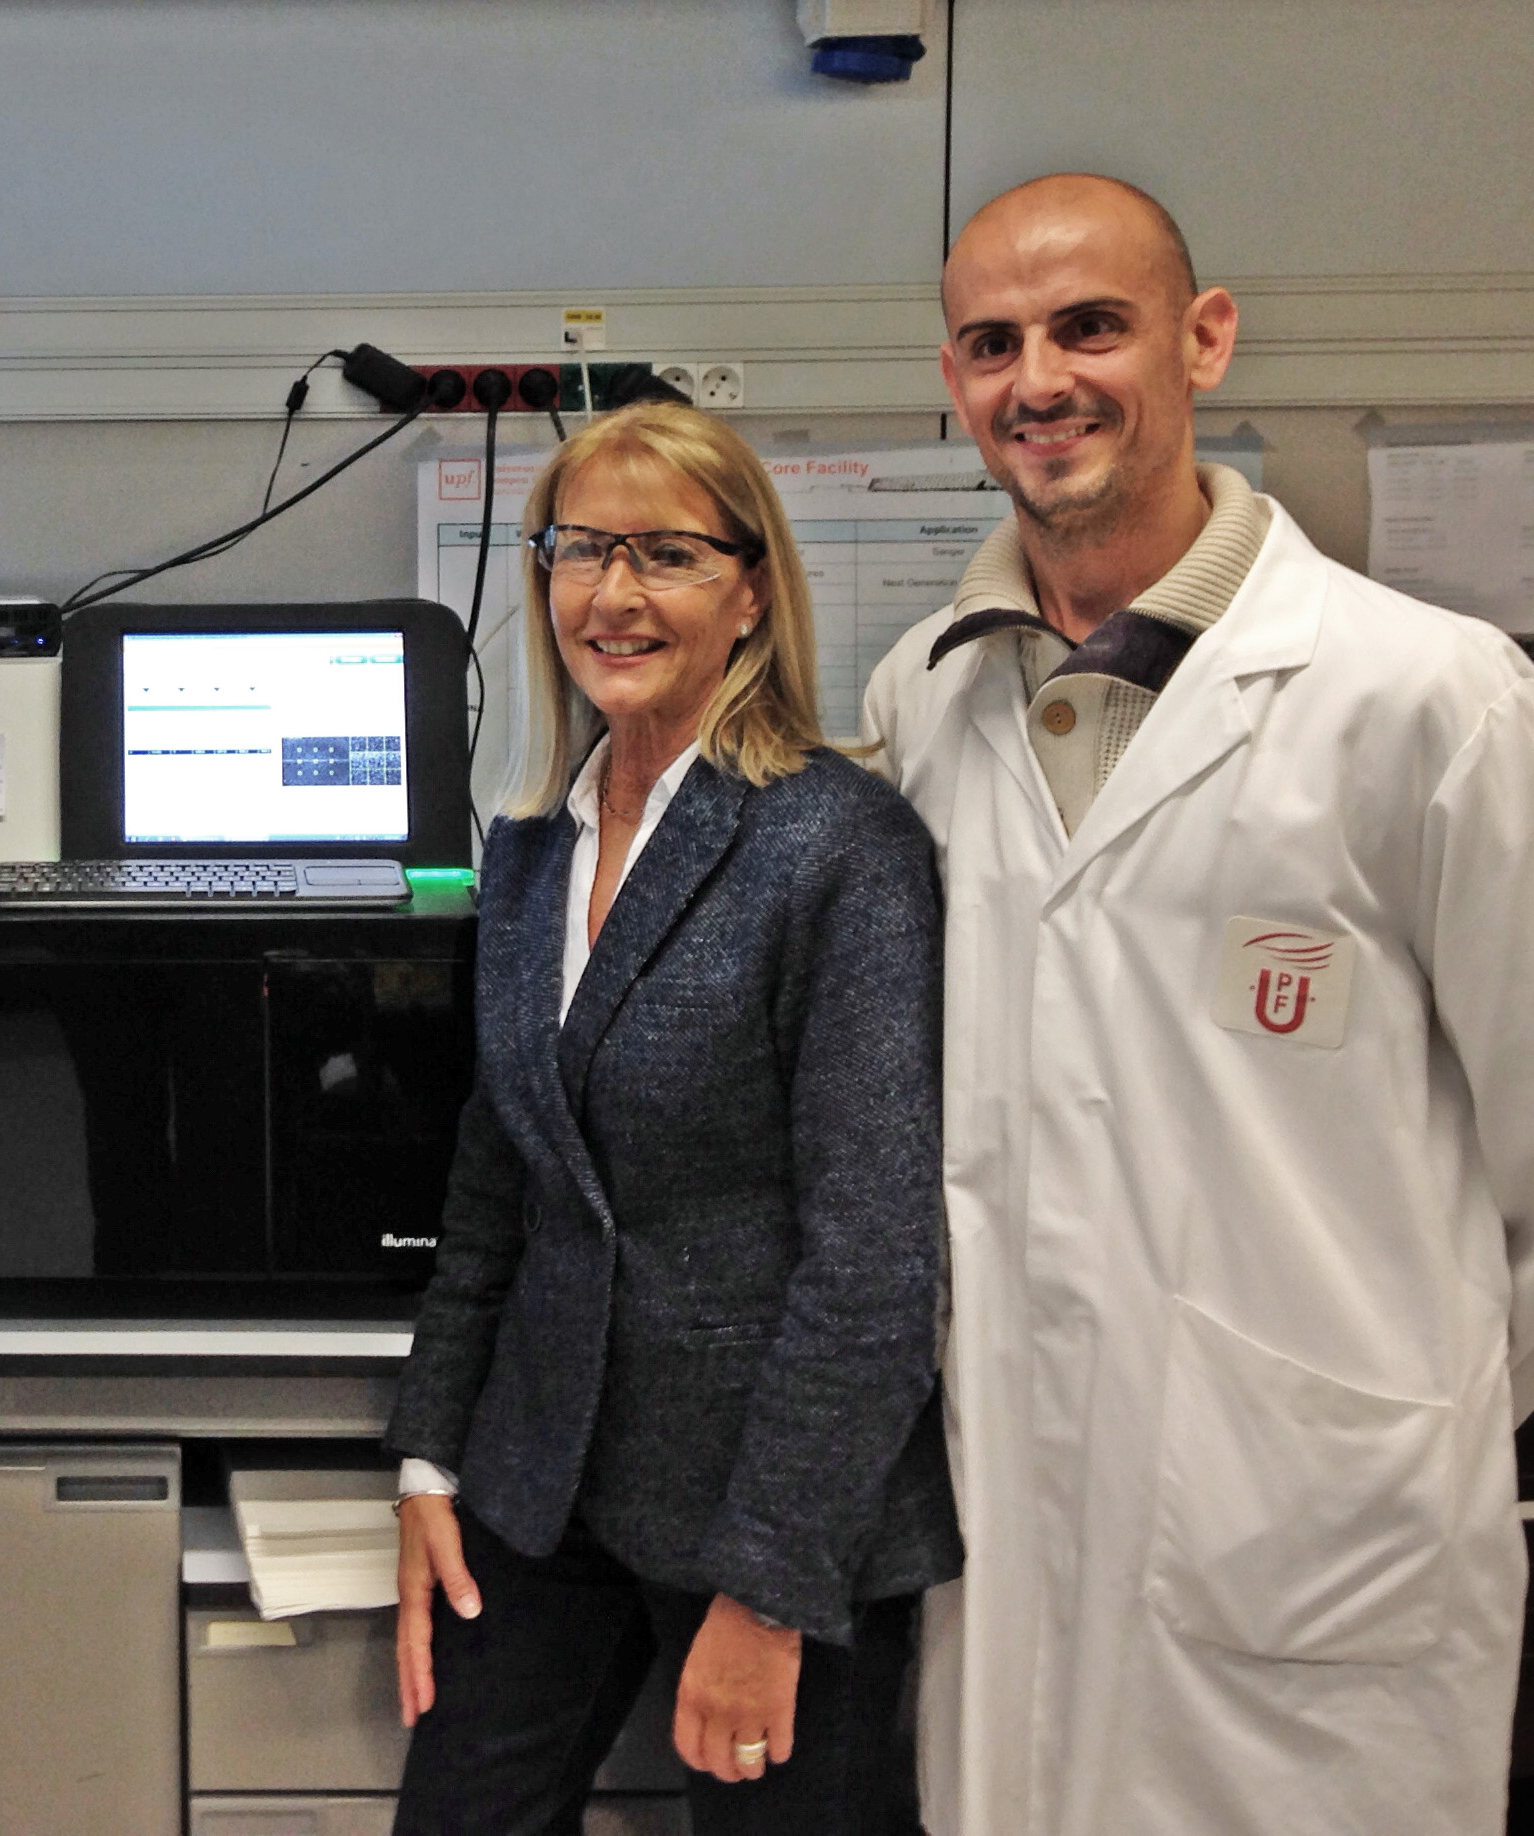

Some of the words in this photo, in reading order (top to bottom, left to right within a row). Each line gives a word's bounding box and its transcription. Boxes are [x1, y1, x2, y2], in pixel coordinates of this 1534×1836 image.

[806, 460, 870, 477] Facility
[444, 469, 475, 489] upf
[459, 530, 482, 540] Inpu
[919, 525, 979, 536] Application
[381, 1233, 437, 1248] illumina
